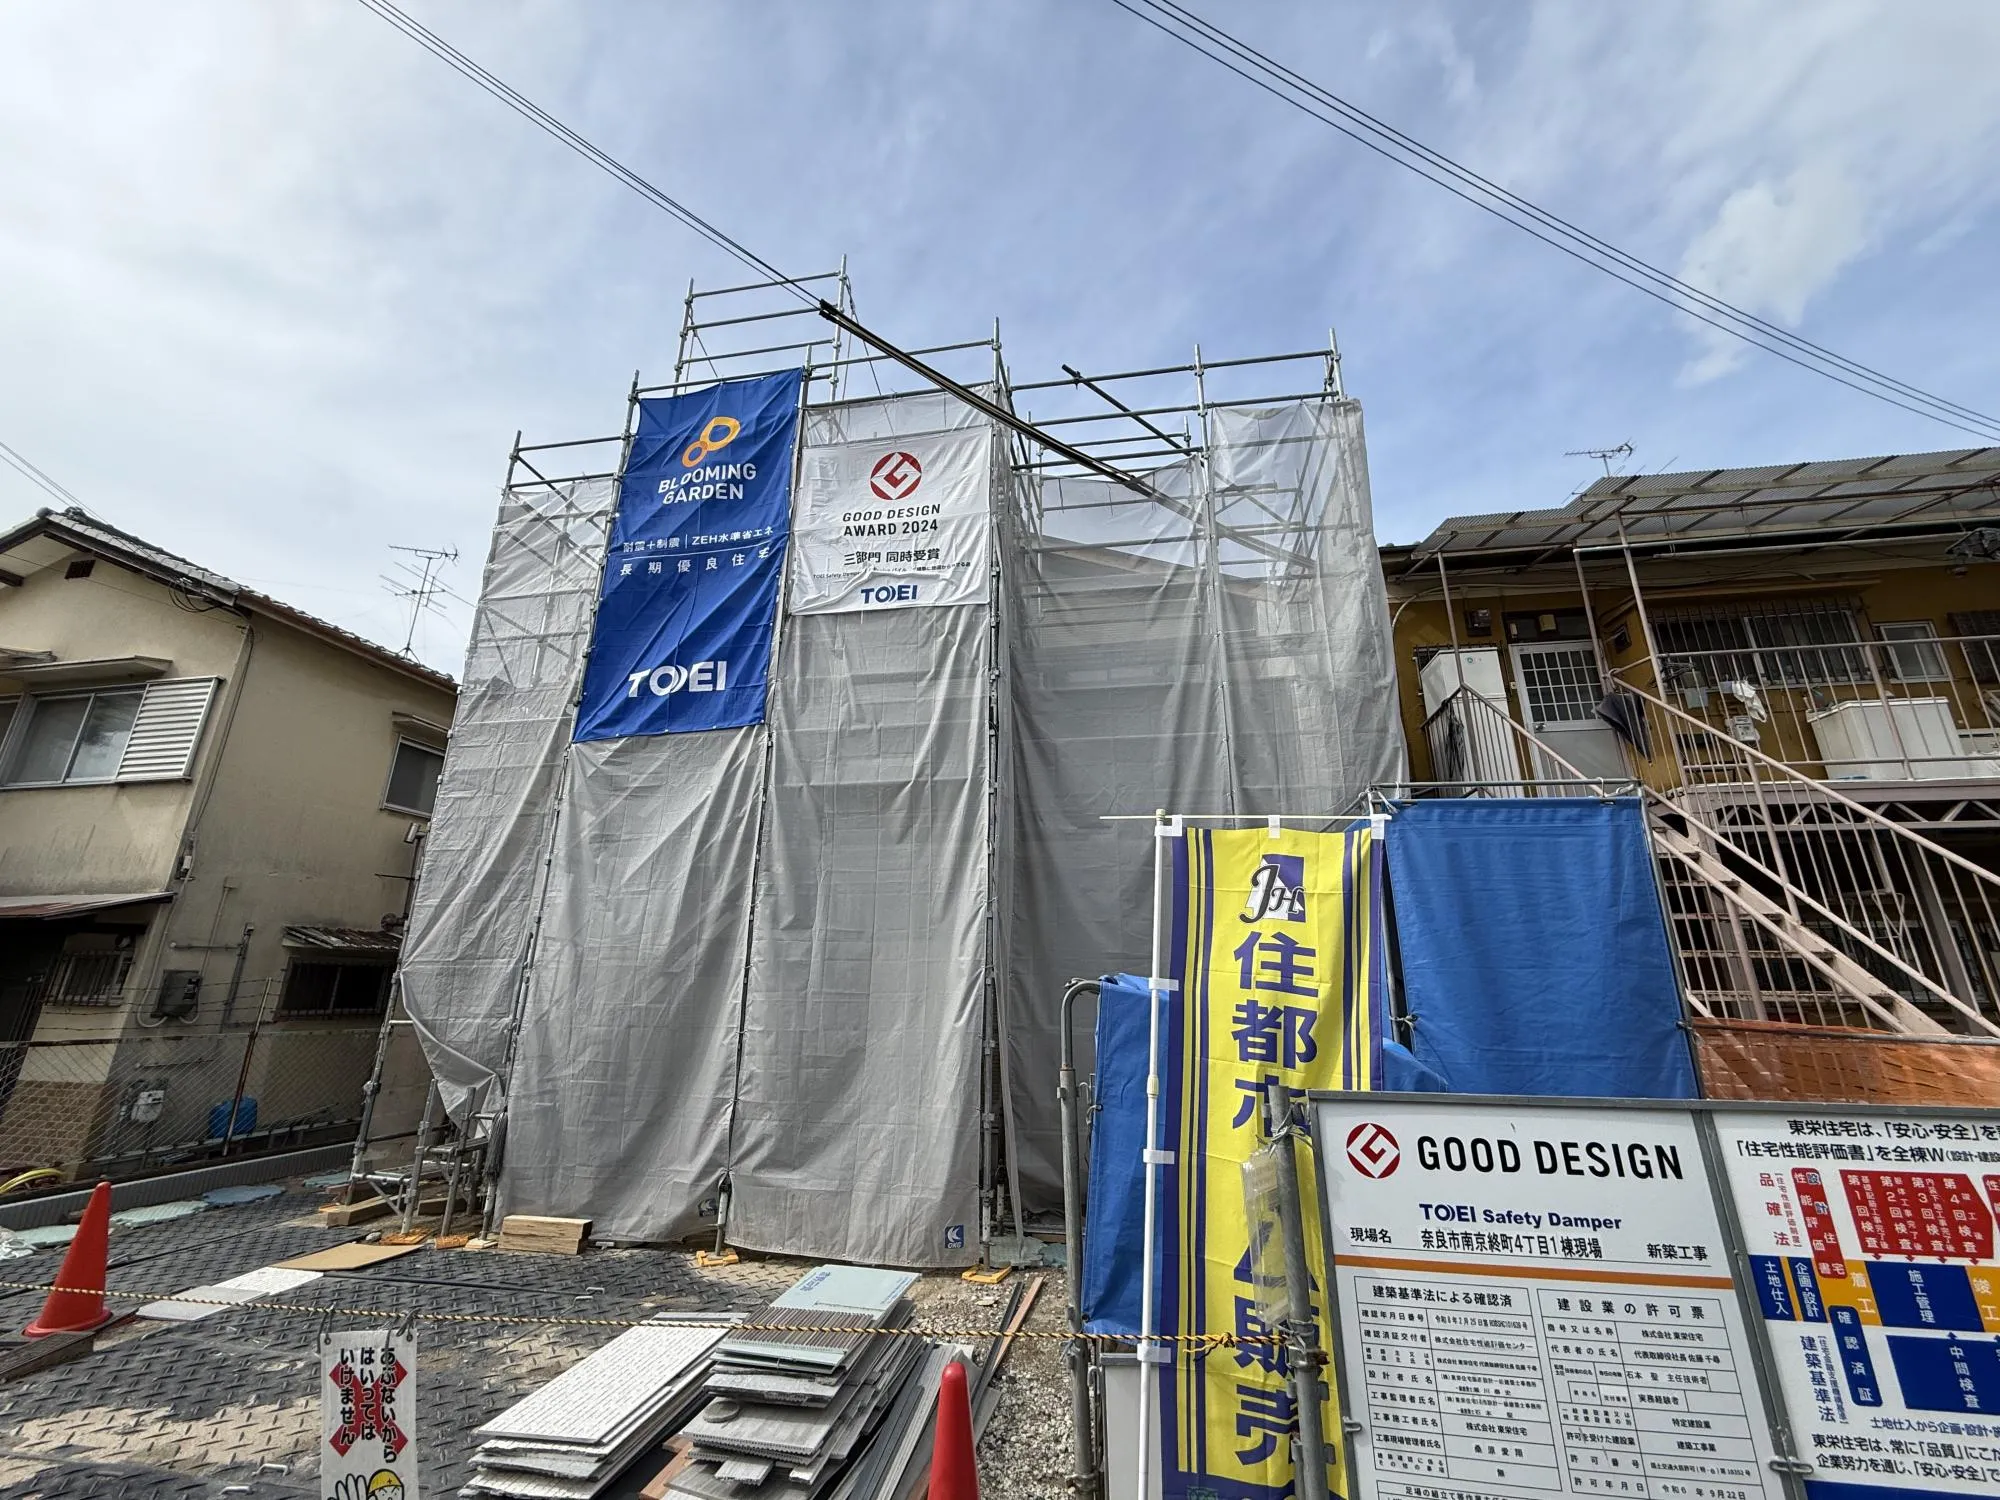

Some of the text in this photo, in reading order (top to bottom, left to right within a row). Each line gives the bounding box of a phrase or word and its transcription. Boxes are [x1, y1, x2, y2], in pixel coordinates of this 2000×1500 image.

[658, 463, 757, 493] BLOOMING
[662, 483, 744, 504] GARDEN
[842, 503, 941, 522] GOOD DESIGN
[843, 519, 938, 536] AWARD 2024
[620, 547, 770, 576] 長期優良住宅
[844, 548, 940, 566] 三部門 同時受賞
[860, 584, 918, 604] TOEI
[628, 660, 727, 697] TOEI
[1417, 1135, 1684, 1180] GOOD DESIGN
[1419, 1203, 1622, 1232] TOEI Safety Damper
[1350, 1227, 1392, 1244] 現場名
[1646, 1243, 1708, 1261] 新築工事
[1372, 1285, 1512, 1308] 建築基準法による確認済
[1764, 1261, 1789, 1316] 土地仕入
[1852, 1272, 1876, 1314] 着工
[1907, 1269, 1936, 1324] 施工管理
[1361, 1309, 1424, 1322] 確認年月日番号
[1557, 1298, 1705, 1320] 建設業の許可票
[1641, 1330, 1672, 1340] 株式会社
[1551, 1344, 1618, 1358] 代表者の氏名
[1836, 1311, 1875, 1402] 確認済証
[1800, 1335, 1836, 1423] 建築基準法
[1949, 1345, 1982, 1409] 中間検査
[340, 1348, 355, 1445] いけません
[360, 1347, 376, 1441] はいっては
[380, 1347, 398, 1464] あぶないから
[1466, 1422, 1496, 1433] 株式会社
[1574, 1477, 1644, 1492] 許可年月日
